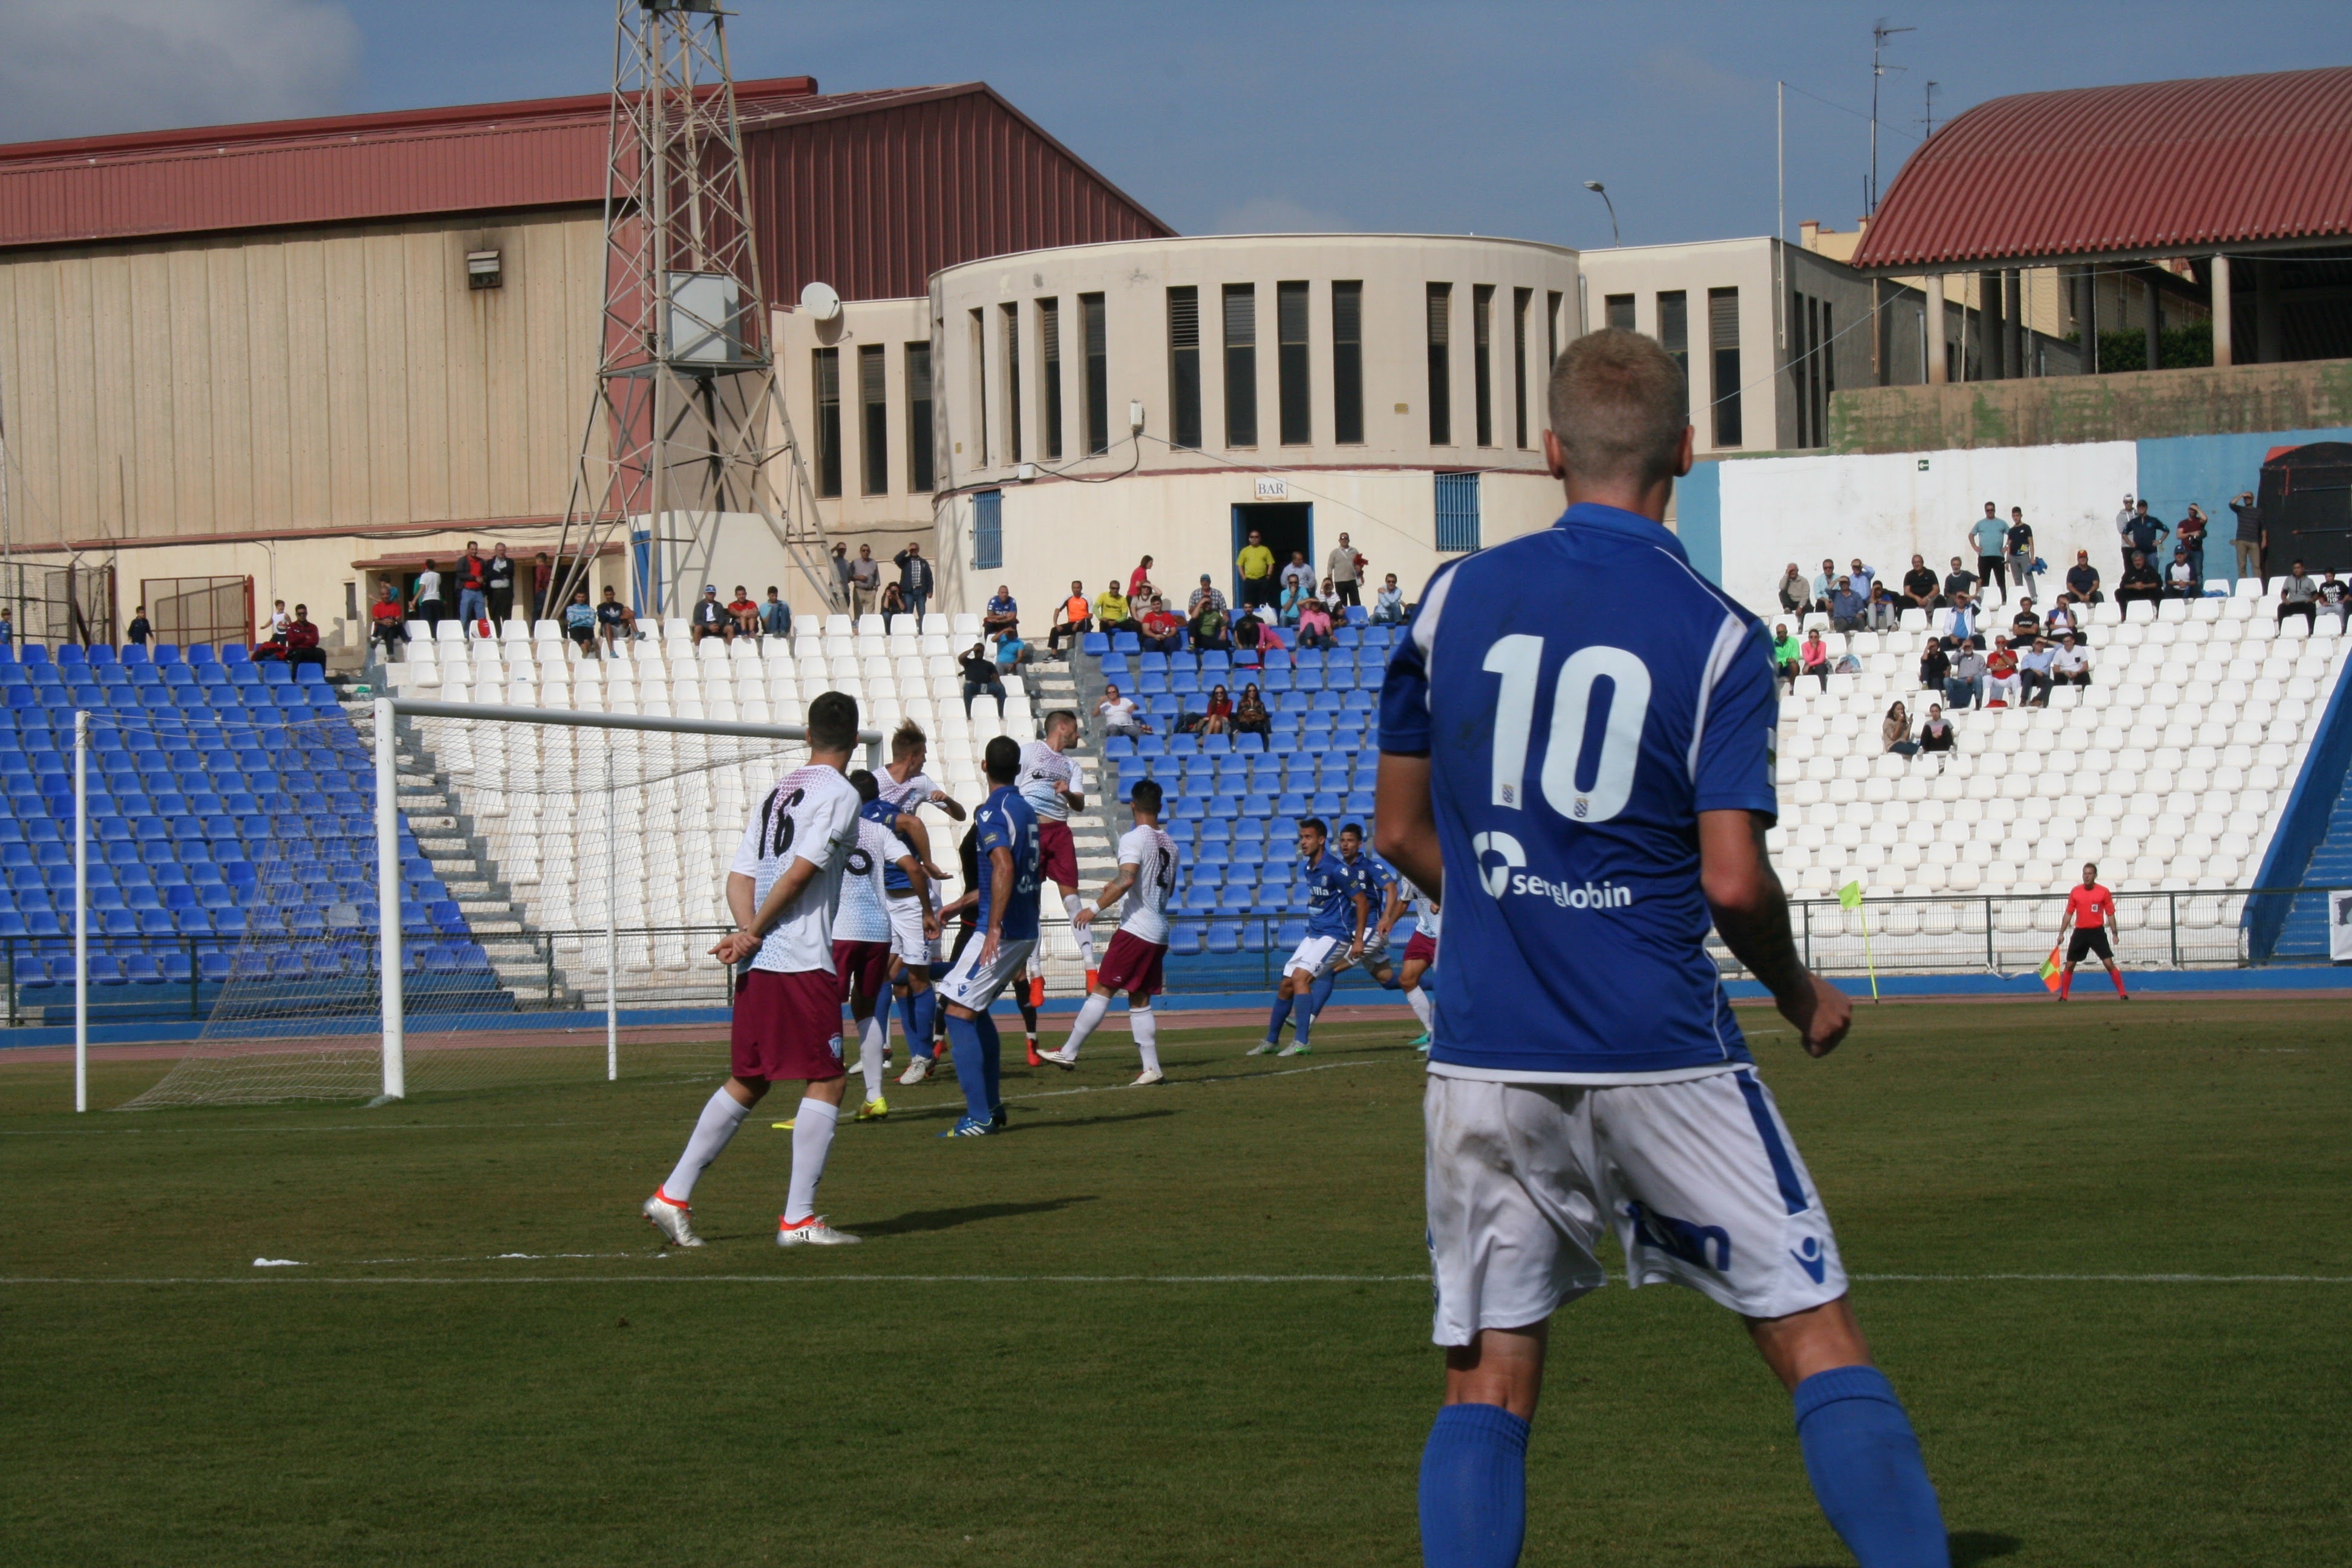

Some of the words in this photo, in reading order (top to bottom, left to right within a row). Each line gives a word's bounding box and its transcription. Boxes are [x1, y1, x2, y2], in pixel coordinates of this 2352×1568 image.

[1258, 483, 1285, 494] BAR
[1482, 633, 1652, 823] 10
[758, 788, 805, 860] 16
[1027, 823, 1040, 872] 5
[1156, 847, 1171, 890] 2
[1512, 873, 1632, 909] serglobin
